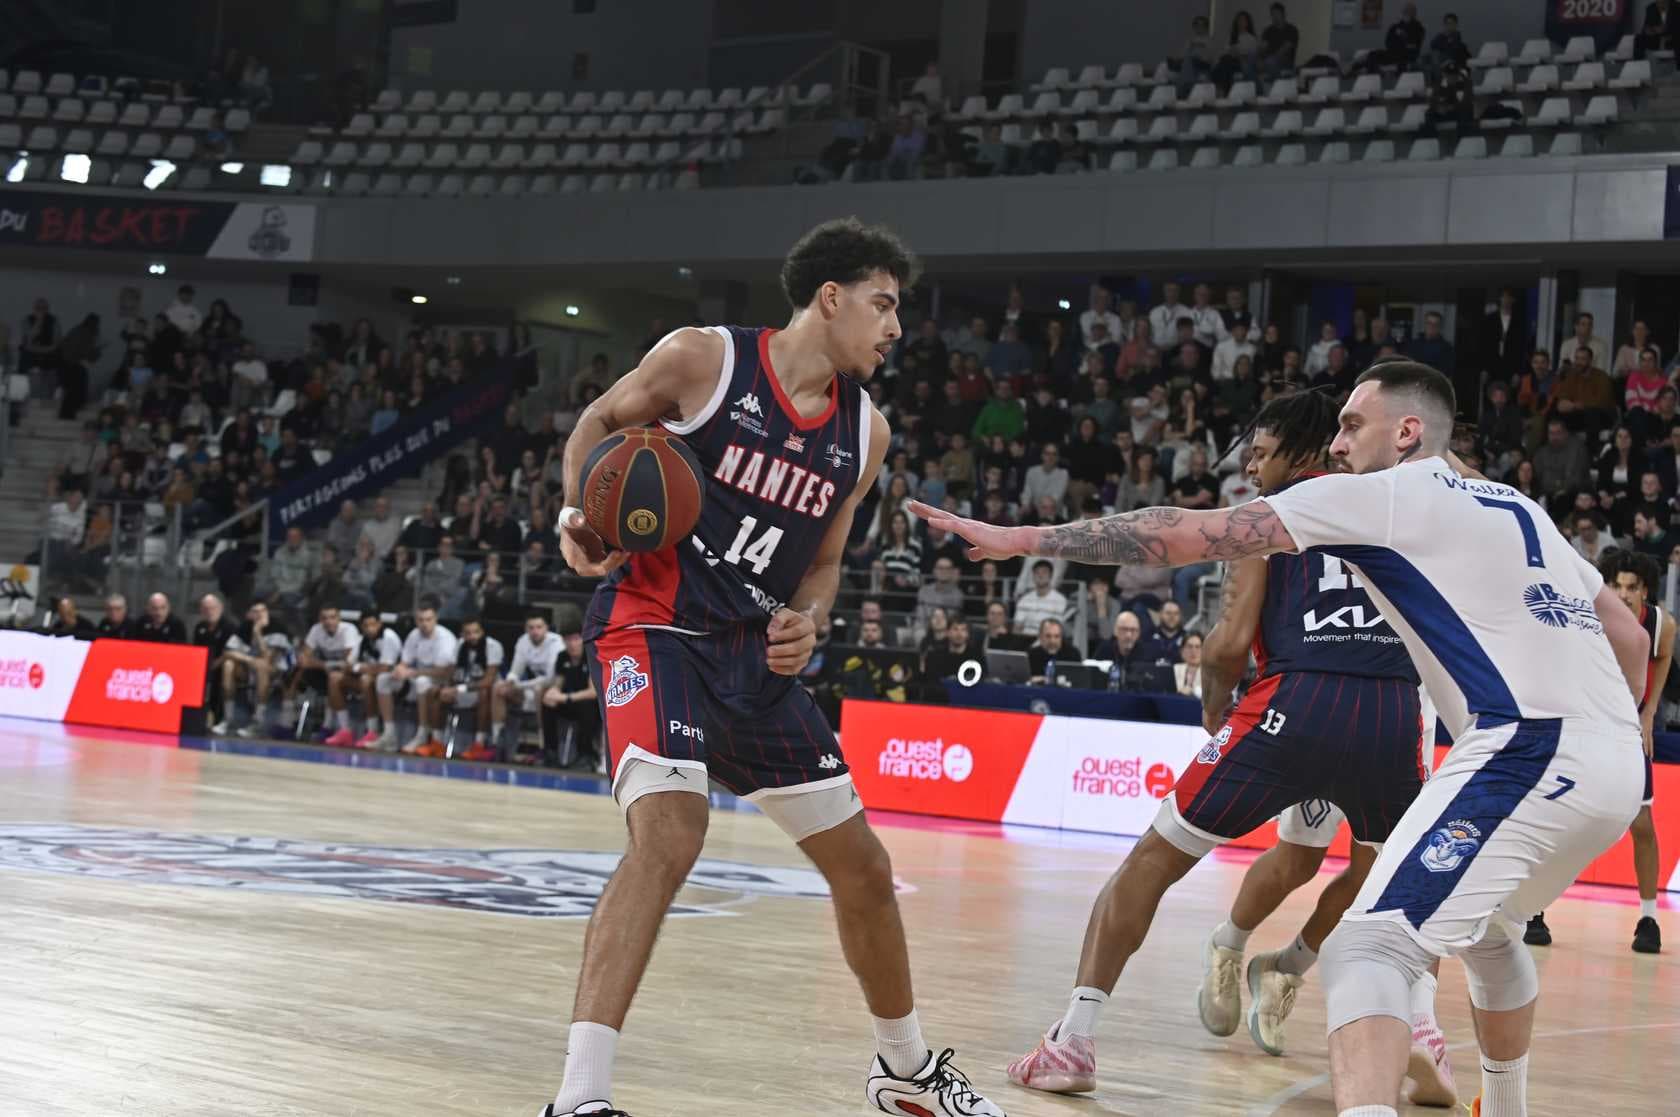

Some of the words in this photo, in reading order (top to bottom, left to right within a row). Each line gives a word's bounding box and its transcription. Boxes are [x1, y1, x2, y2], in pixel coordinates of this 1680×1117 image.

[1562, 0, 1617, 19] 2020
[37, 206, 202, 244] BASKET
[713, 443, 837, 518] NANTES
[723, 514, 785, 576] 14
[1472, 495, 1546, 569] 7
[1318, 552, 1367, 593] 1
[1303, 634, 1352, 643] Movement
[1354, 632, 1371, 642] that
[1372, 633, 1401, 645] inspire
[1260, 708, 1287, 736] 13
[886, 737, 944, 761] ouest
[878, 752, 943, 781] france
[1081, 756, 1141, 779] ouest
[1072, 769, 1141, 798] france
[1543, 775, 1577, 801] 7
